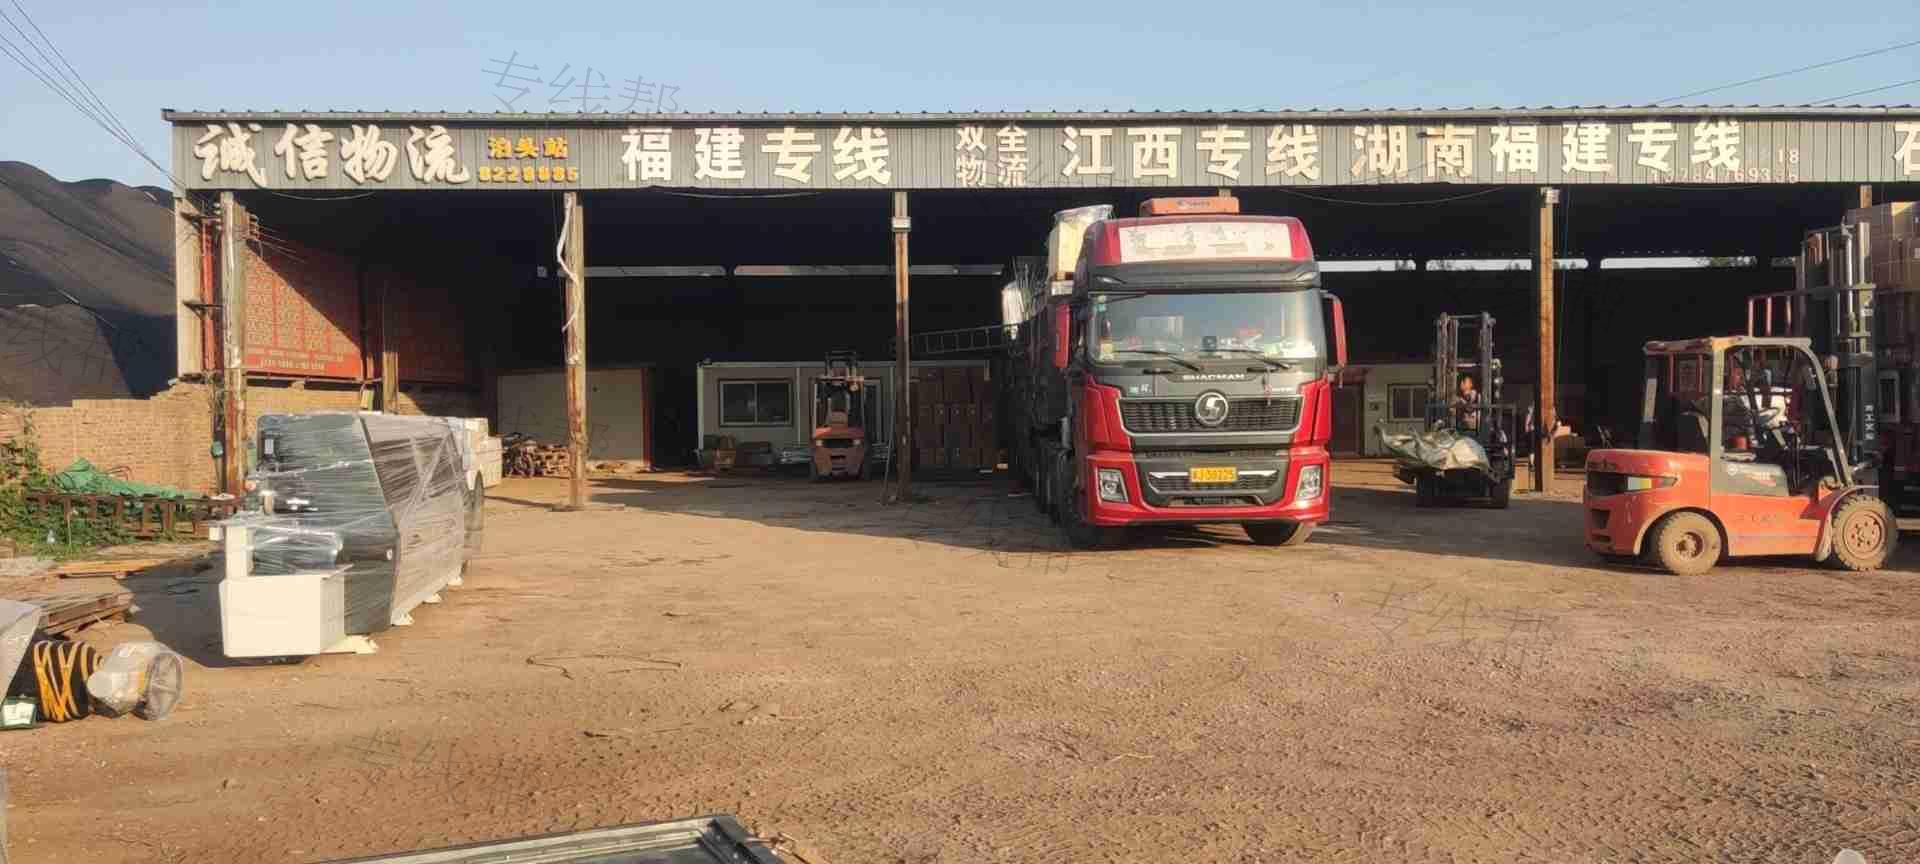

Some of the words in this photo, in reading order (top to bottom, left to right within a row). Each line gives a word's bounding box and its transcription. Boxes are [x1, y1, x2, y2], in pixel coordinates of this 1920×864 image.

[193, 122, 469, 188] 诚信物流
[487, 136, 568, 159] 泊头站
[620, 126, 892, 184] 福建专线
[956, 125, 1028, 152] 双全
[1060, 124, 1320, 180] 江西专线
[1350, 121, 1740, 177] 湖南福建专线
[956, 153, 1028, 187] 物流
